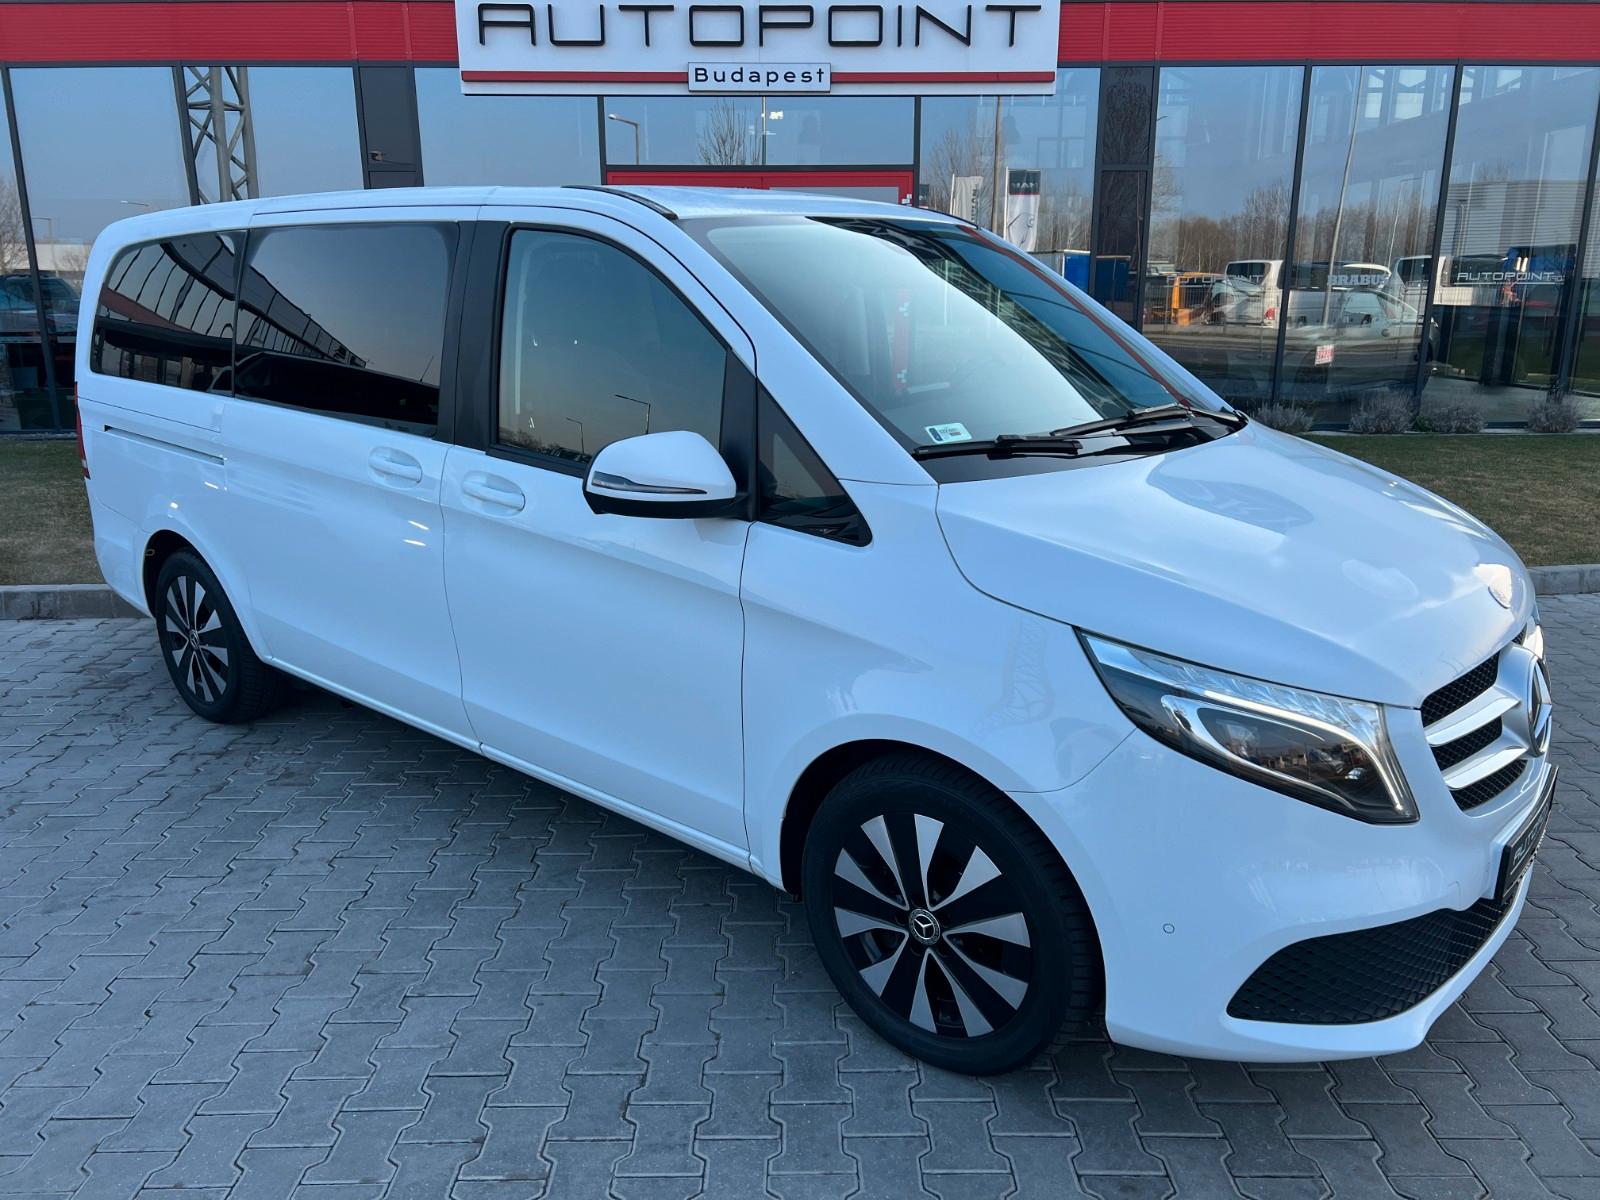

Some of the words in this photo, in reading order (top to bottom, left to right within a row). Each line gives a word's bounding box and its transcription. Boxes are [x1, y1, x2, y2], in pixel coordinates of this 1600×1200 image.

[477, 3, 1042, 47] AUTOPOINT
[694, 67, 825, 87] Budapest
[1456, 271, 1554, 281] AUTOPOINT
